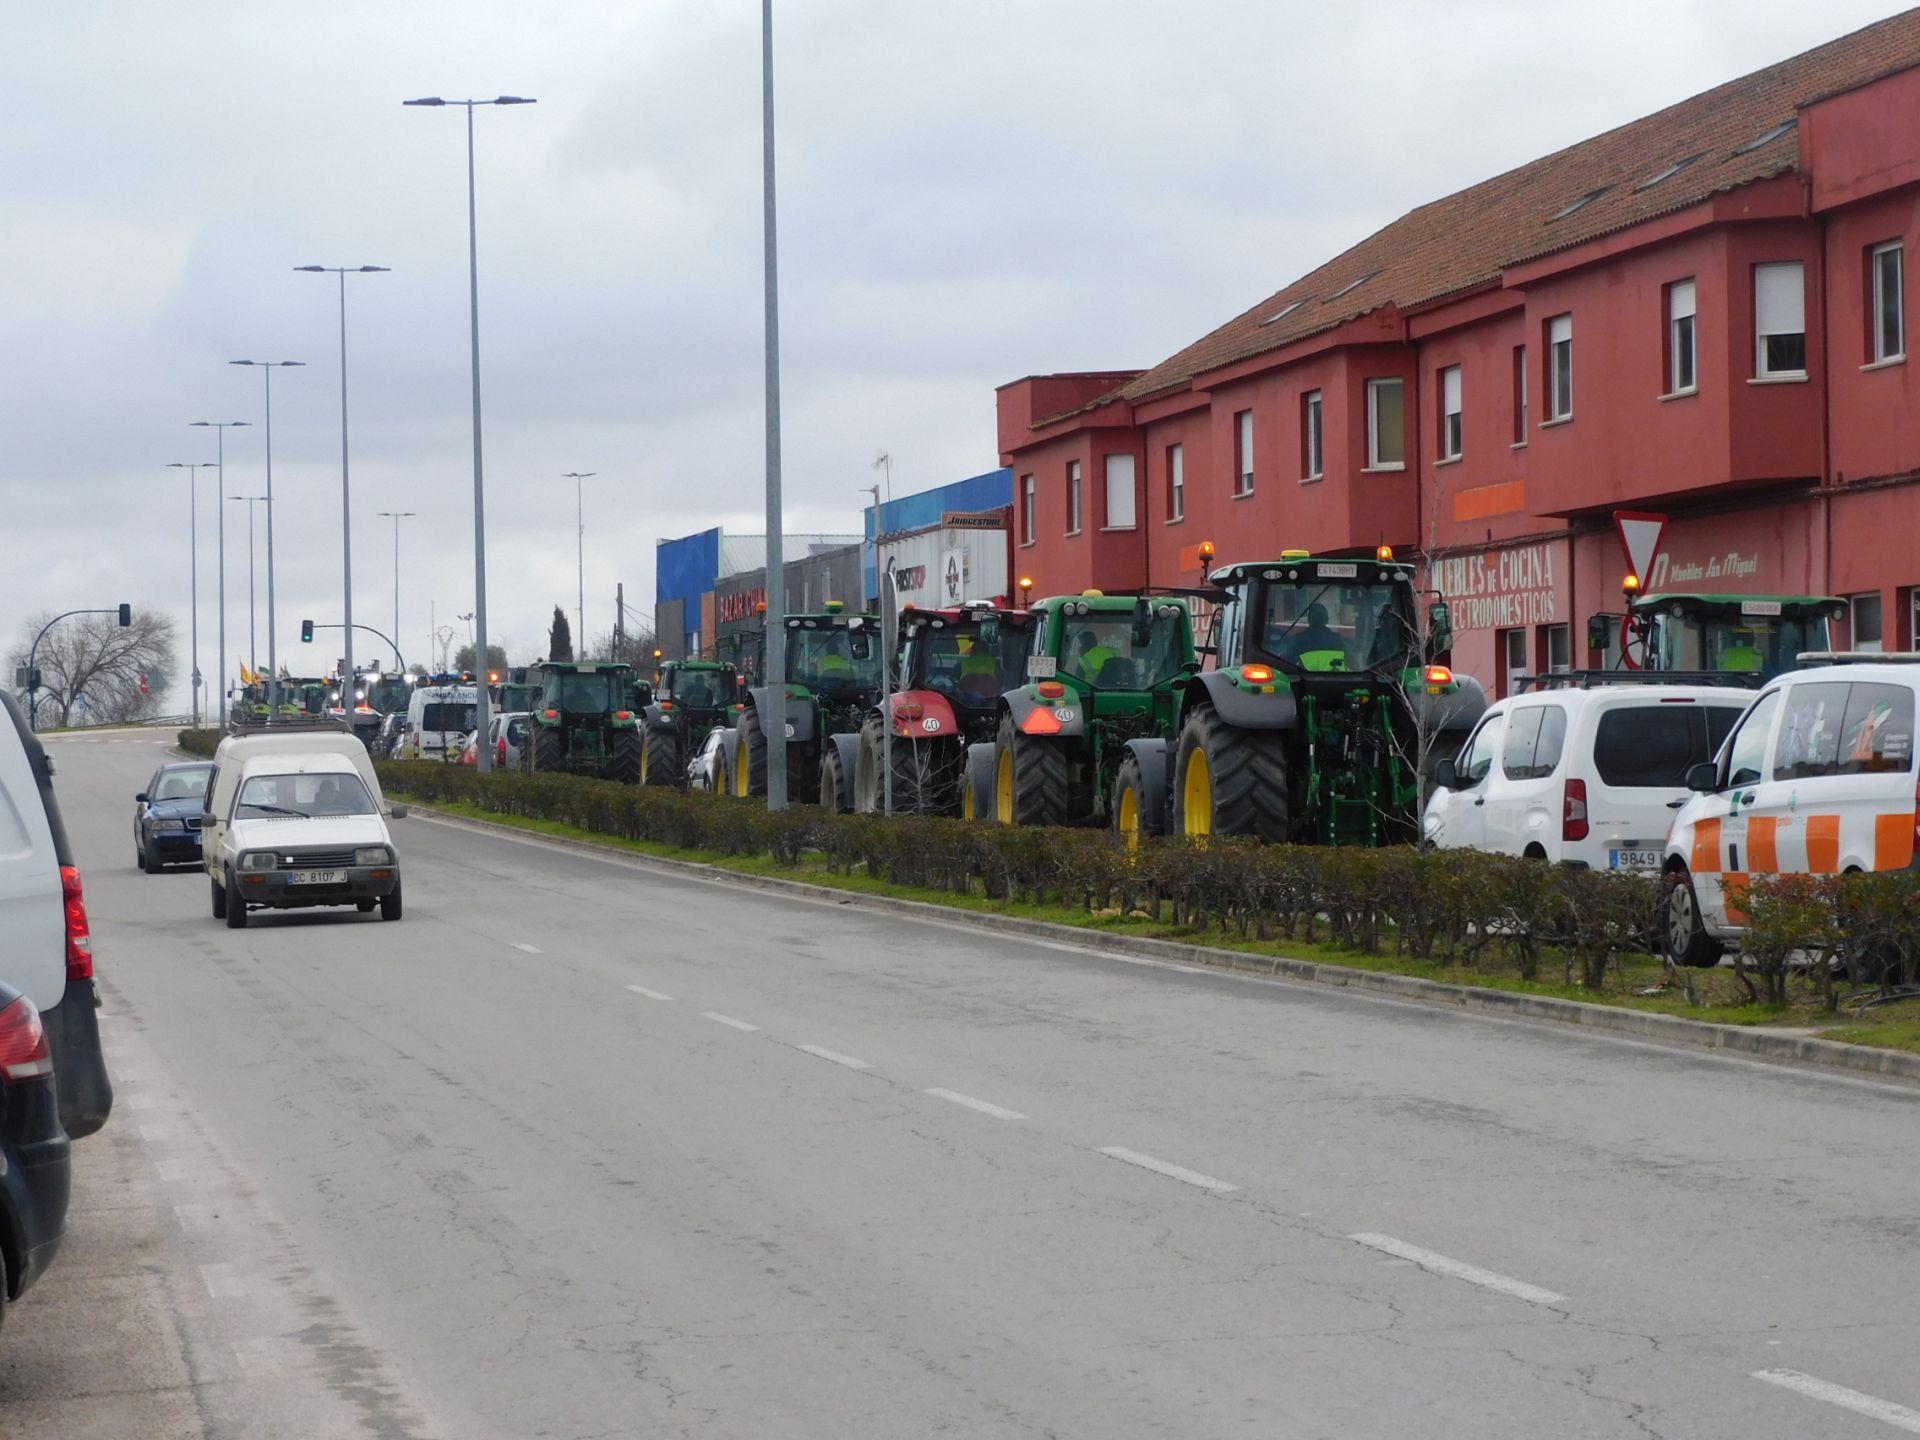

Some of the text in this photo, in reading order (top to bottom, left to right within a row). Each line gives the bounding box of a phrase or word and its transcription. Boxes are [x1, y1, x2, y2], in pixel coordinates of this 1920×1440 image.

[948, 516, 1001, 526] BRIDGESTONE
[1431, 545, 1552, 598] MUEBLES DE COCINA
[1670, 562, 1703, 582] Muebles
[1705, 556, 1720, 578] San
[1722, 552, 1758, 578] Miguel
[721, 592, 744, 623] BAZAR
[1446, 590, 1554, 630] ECTRODOMESTICOS
[1057, 710, 1071, 720] 40
[925, 719, 938, 729] 40
[1620, 852, 1655, 865] 9849
[310, 872, 334, 882] 8107
[341, 871, 346, 881] J
